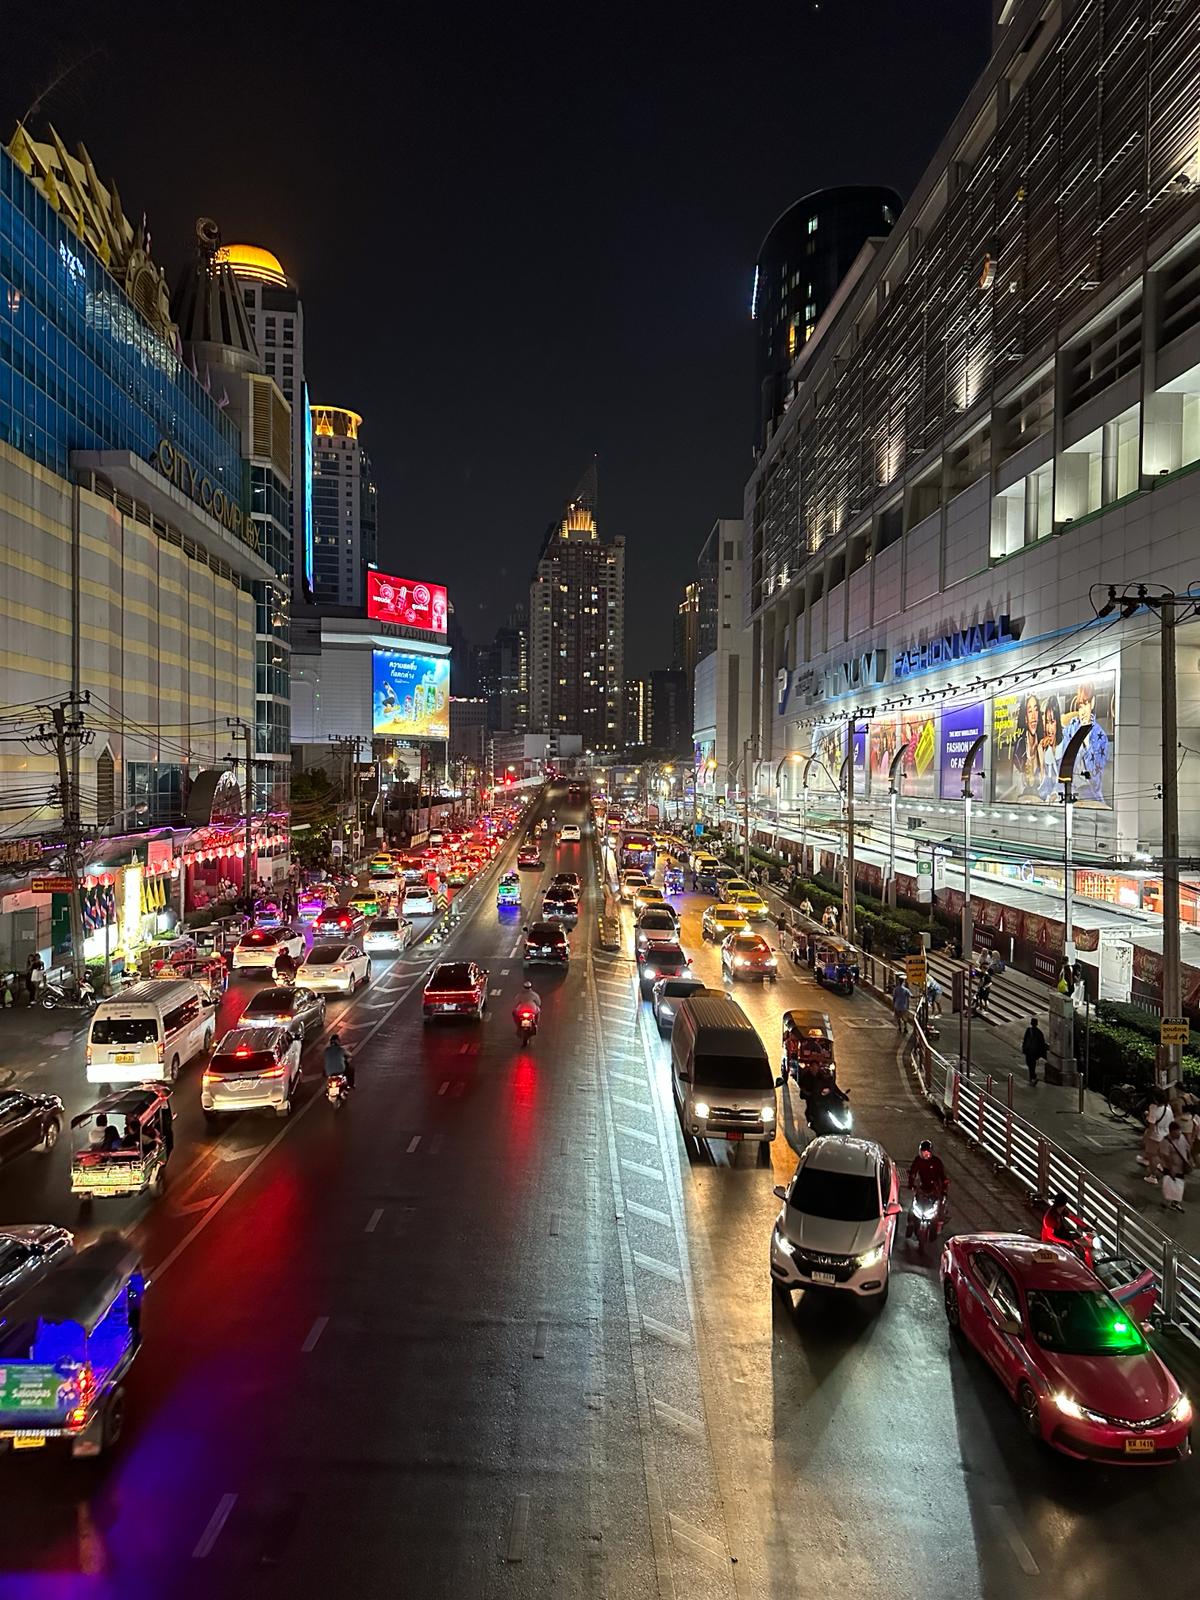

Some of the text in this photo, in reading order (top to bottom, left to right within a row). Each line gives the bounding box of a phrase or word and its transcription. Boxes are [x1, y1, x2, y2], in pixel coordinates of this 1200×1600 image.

[159, 439, 260, 552] CITY COMPLEX
[381, 622, 438, 643] PALLADIUM
[893, 637, 953, 677] FASHION
[958, 615, 1013, 657] MALL
[946, 742, 969, 753] FASHION
[950, 758, 958, 769] OF
